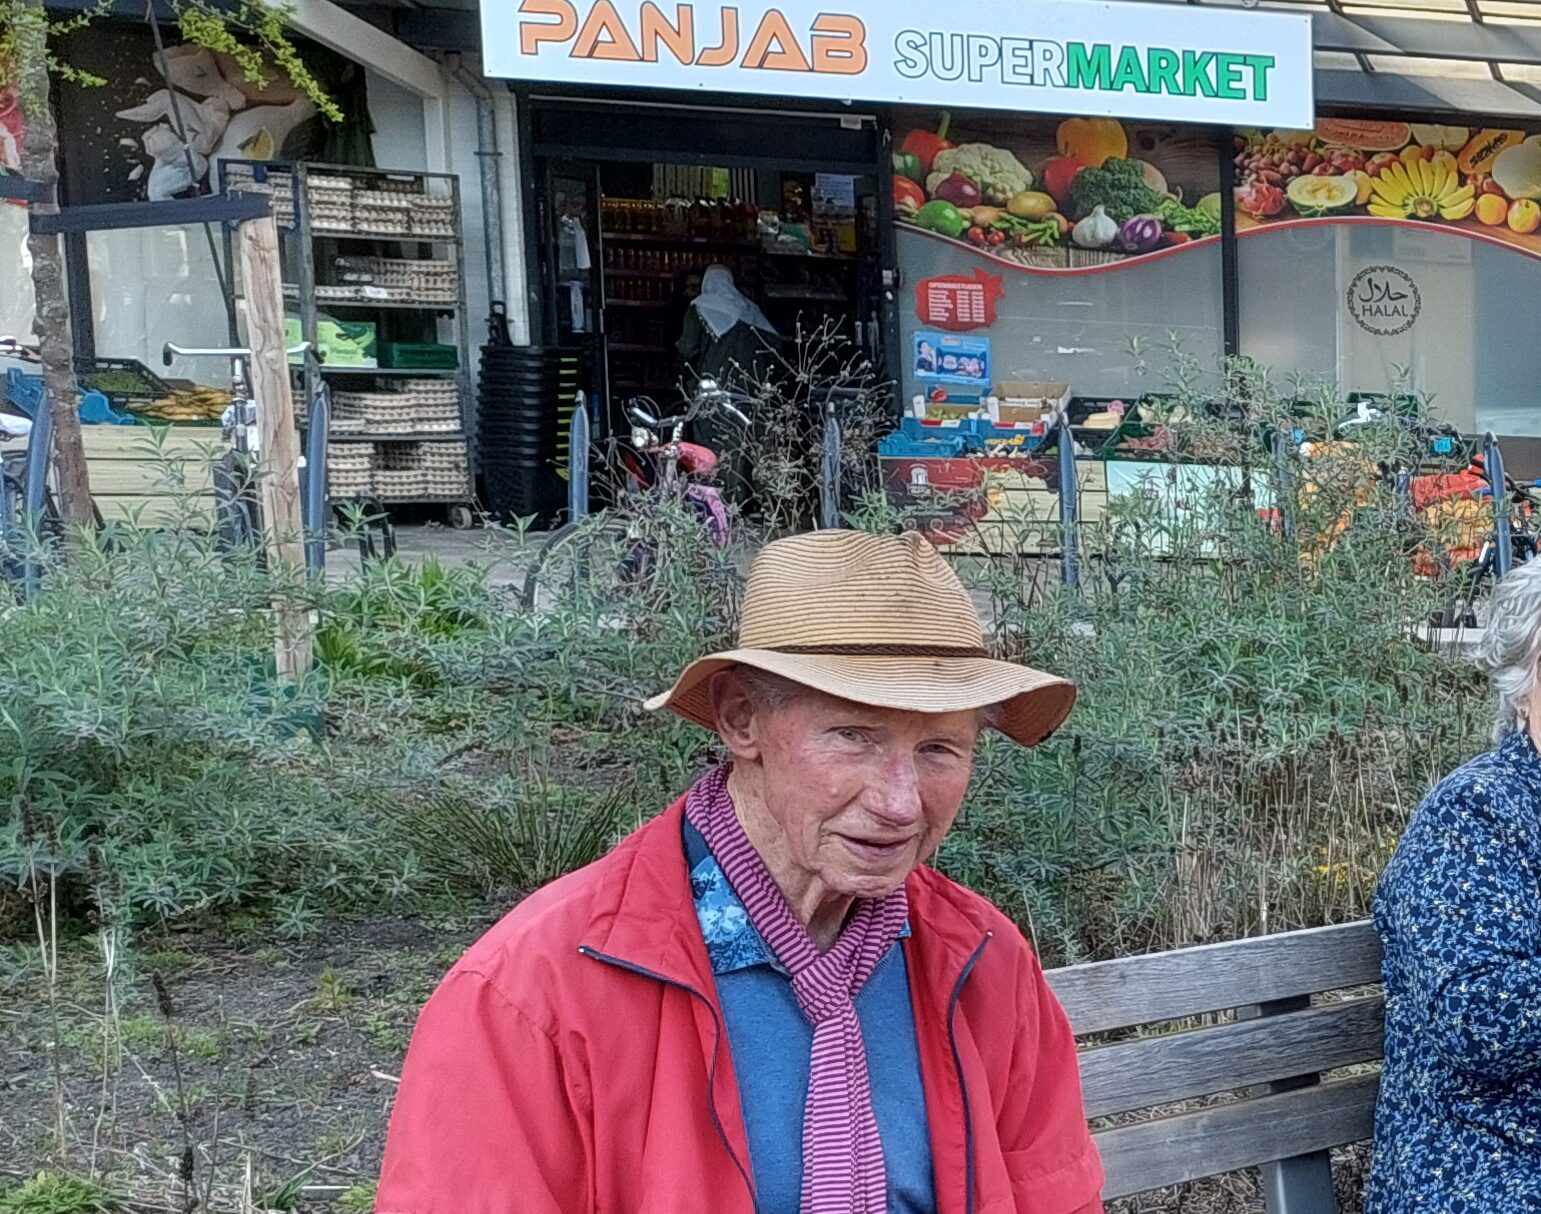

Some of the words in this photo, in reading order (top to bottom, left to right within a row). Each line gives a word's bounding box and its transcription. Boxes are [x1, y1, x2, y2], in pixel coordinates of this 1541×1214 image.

[518, 0, 868, 75] PANJAB
[893, 29, 1276, 101] SUPERMARKET
[1358, 277, 1409, 303] حلال
[1361, 304, 1409, 317] HALAL
